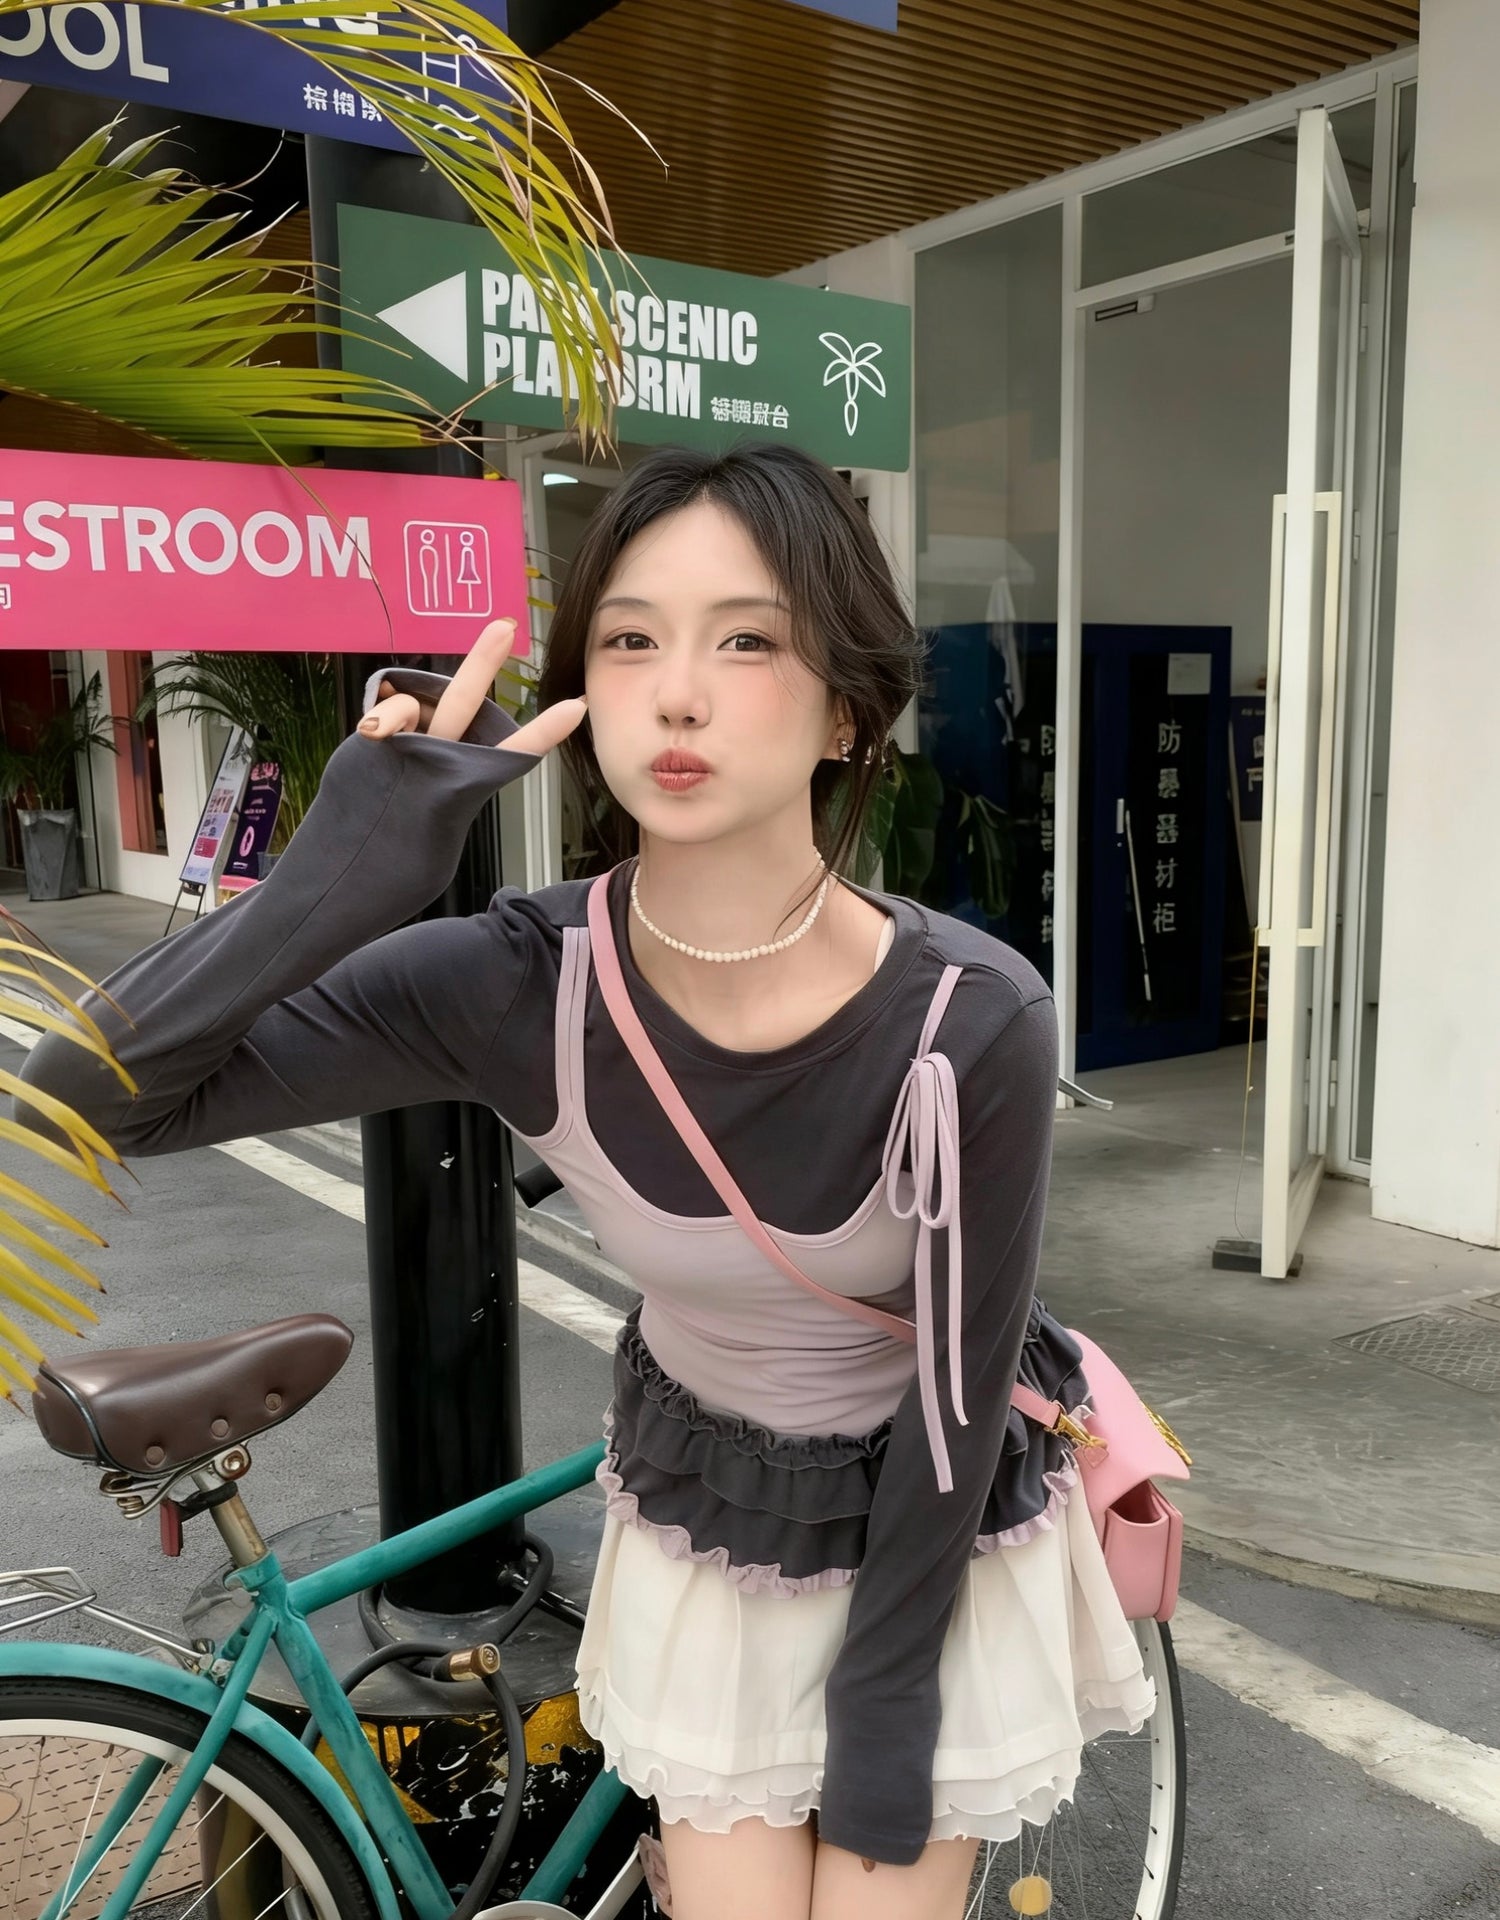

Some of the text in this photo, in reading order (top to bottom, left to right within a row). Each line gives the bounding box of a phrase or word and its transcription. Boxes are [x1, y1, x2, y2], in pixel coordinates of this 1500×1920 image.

[0, 2, 170, 84] OOL
[610, 289, 758, 366] SCENIC
[0, 499, 373, 580] ESTROOM
